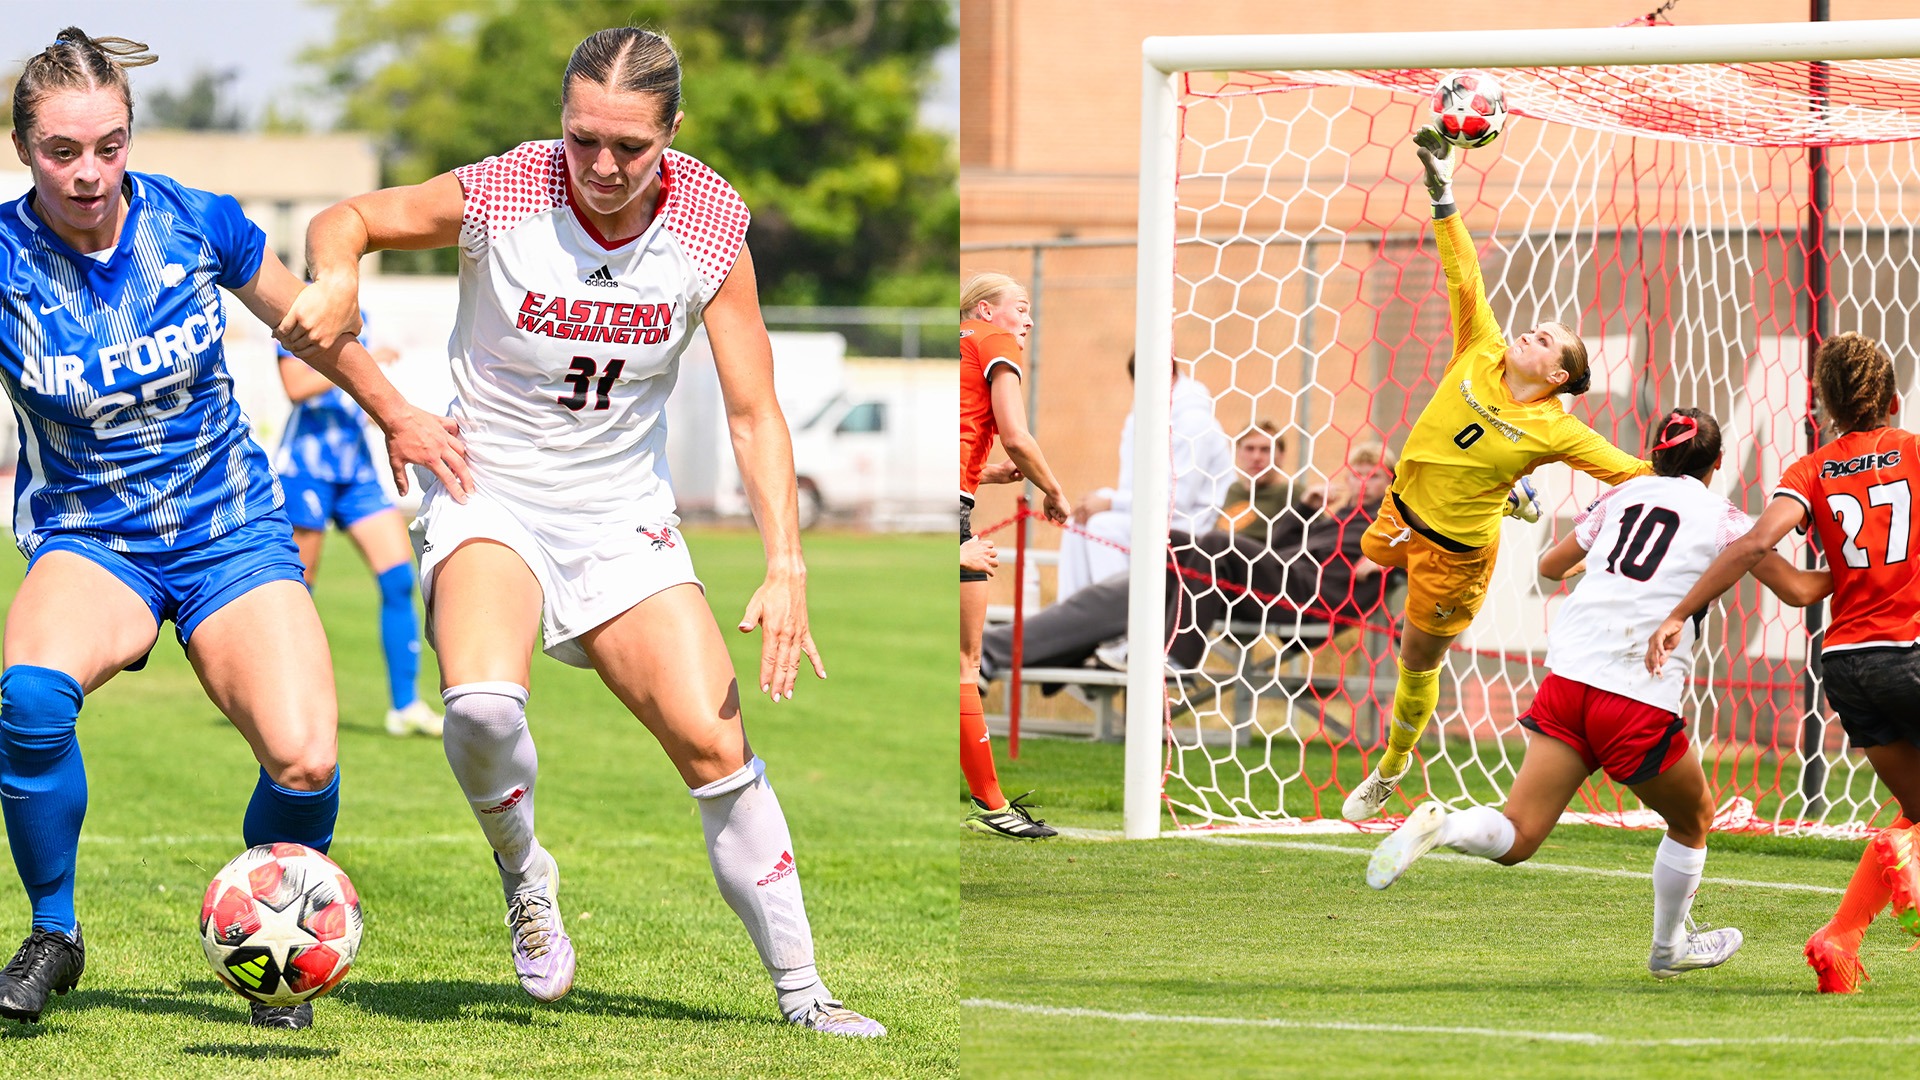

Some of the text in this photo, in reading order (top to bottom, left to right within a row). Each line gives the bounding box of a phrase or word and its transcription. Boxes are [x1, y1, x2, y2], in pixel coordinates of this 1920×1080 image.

[585, 278, 619, 288] adidas
[516, 313, 672, 345] WASHINGTON
[519, 290, 677, 327] EASTERN
[20, 302, 224, 396] AIR FORCE
[85, 370, 194, 441] 25
[557, 356, 626, 412] 31
[1453, 422, 1485, 450] 0
[1819, 450, 1901, 479] PACIFIC
[1605, 503, 1681, 582] 10
[1826, 478, 1912, 569] 27
